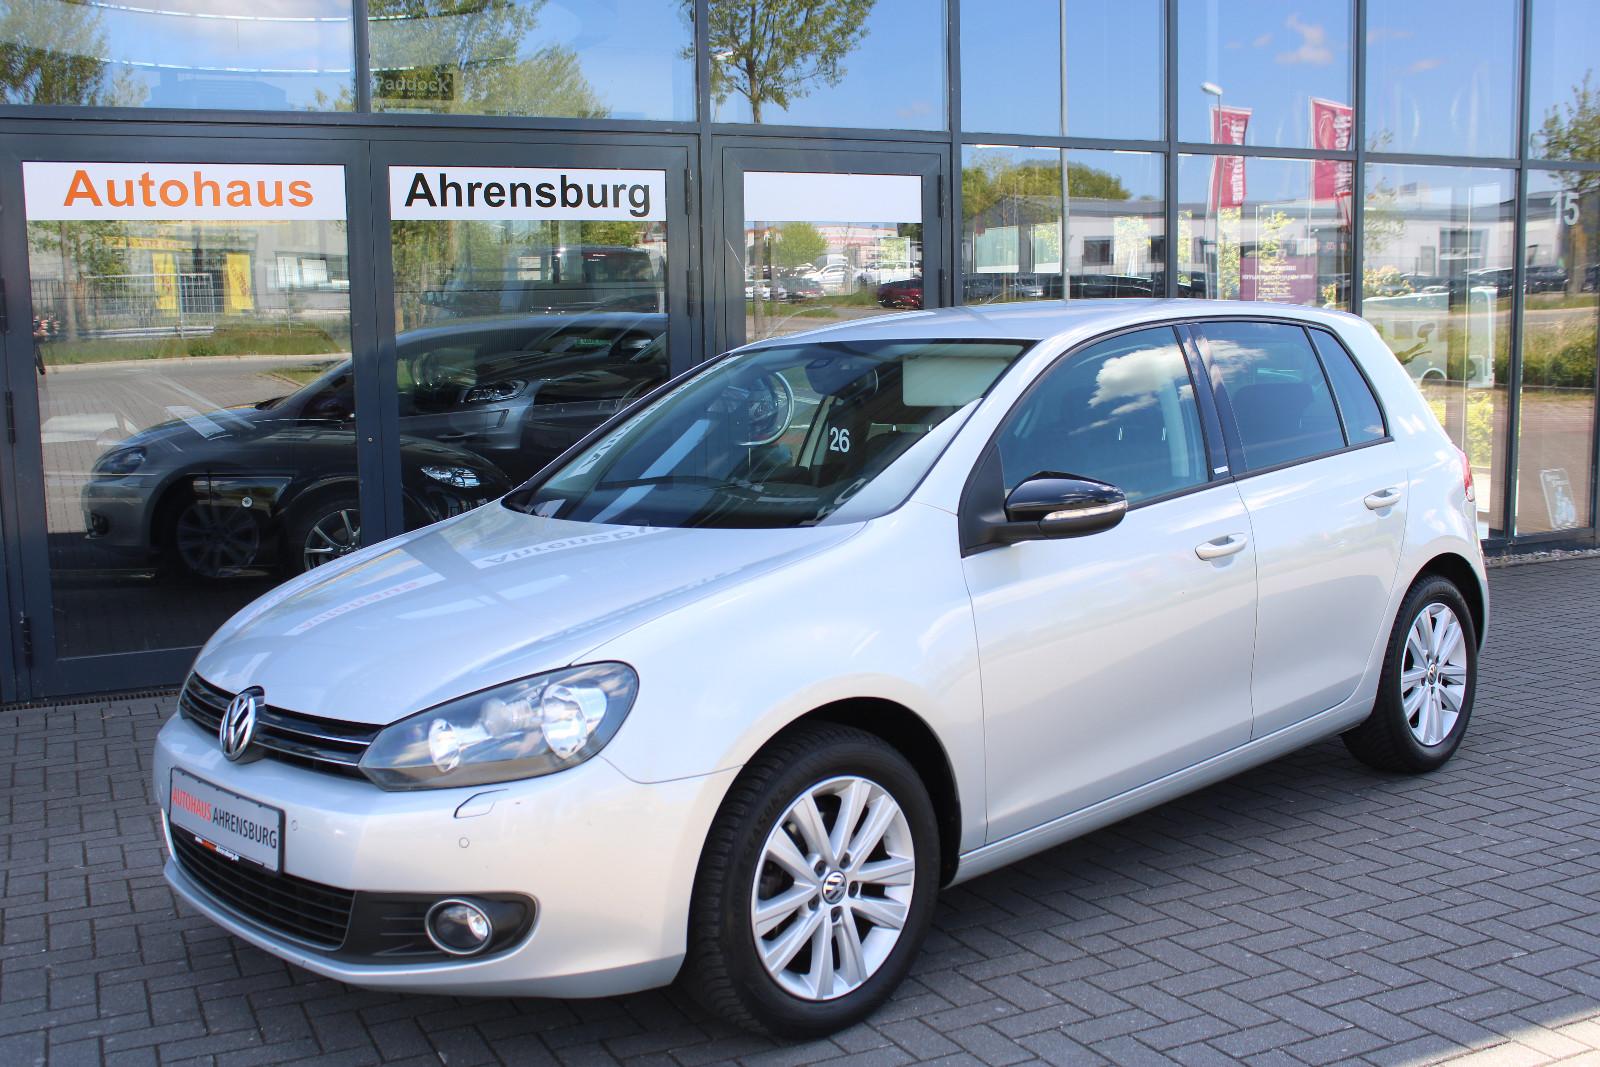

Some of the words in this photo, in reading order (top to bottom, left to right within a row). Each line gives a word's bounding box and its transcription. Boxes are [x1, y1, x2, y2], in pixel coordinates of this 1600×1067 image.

[63, 169, 314, 208] Autohaus
[404, 172, 651, 218] Ahrensburg
[1550, 191, 1580, 226] 15
[829, 426, 850, 453] 26
[172, 787, 212, 823] AUTOHAUS
[212, 807, 278, 849] AHRENSBURG
